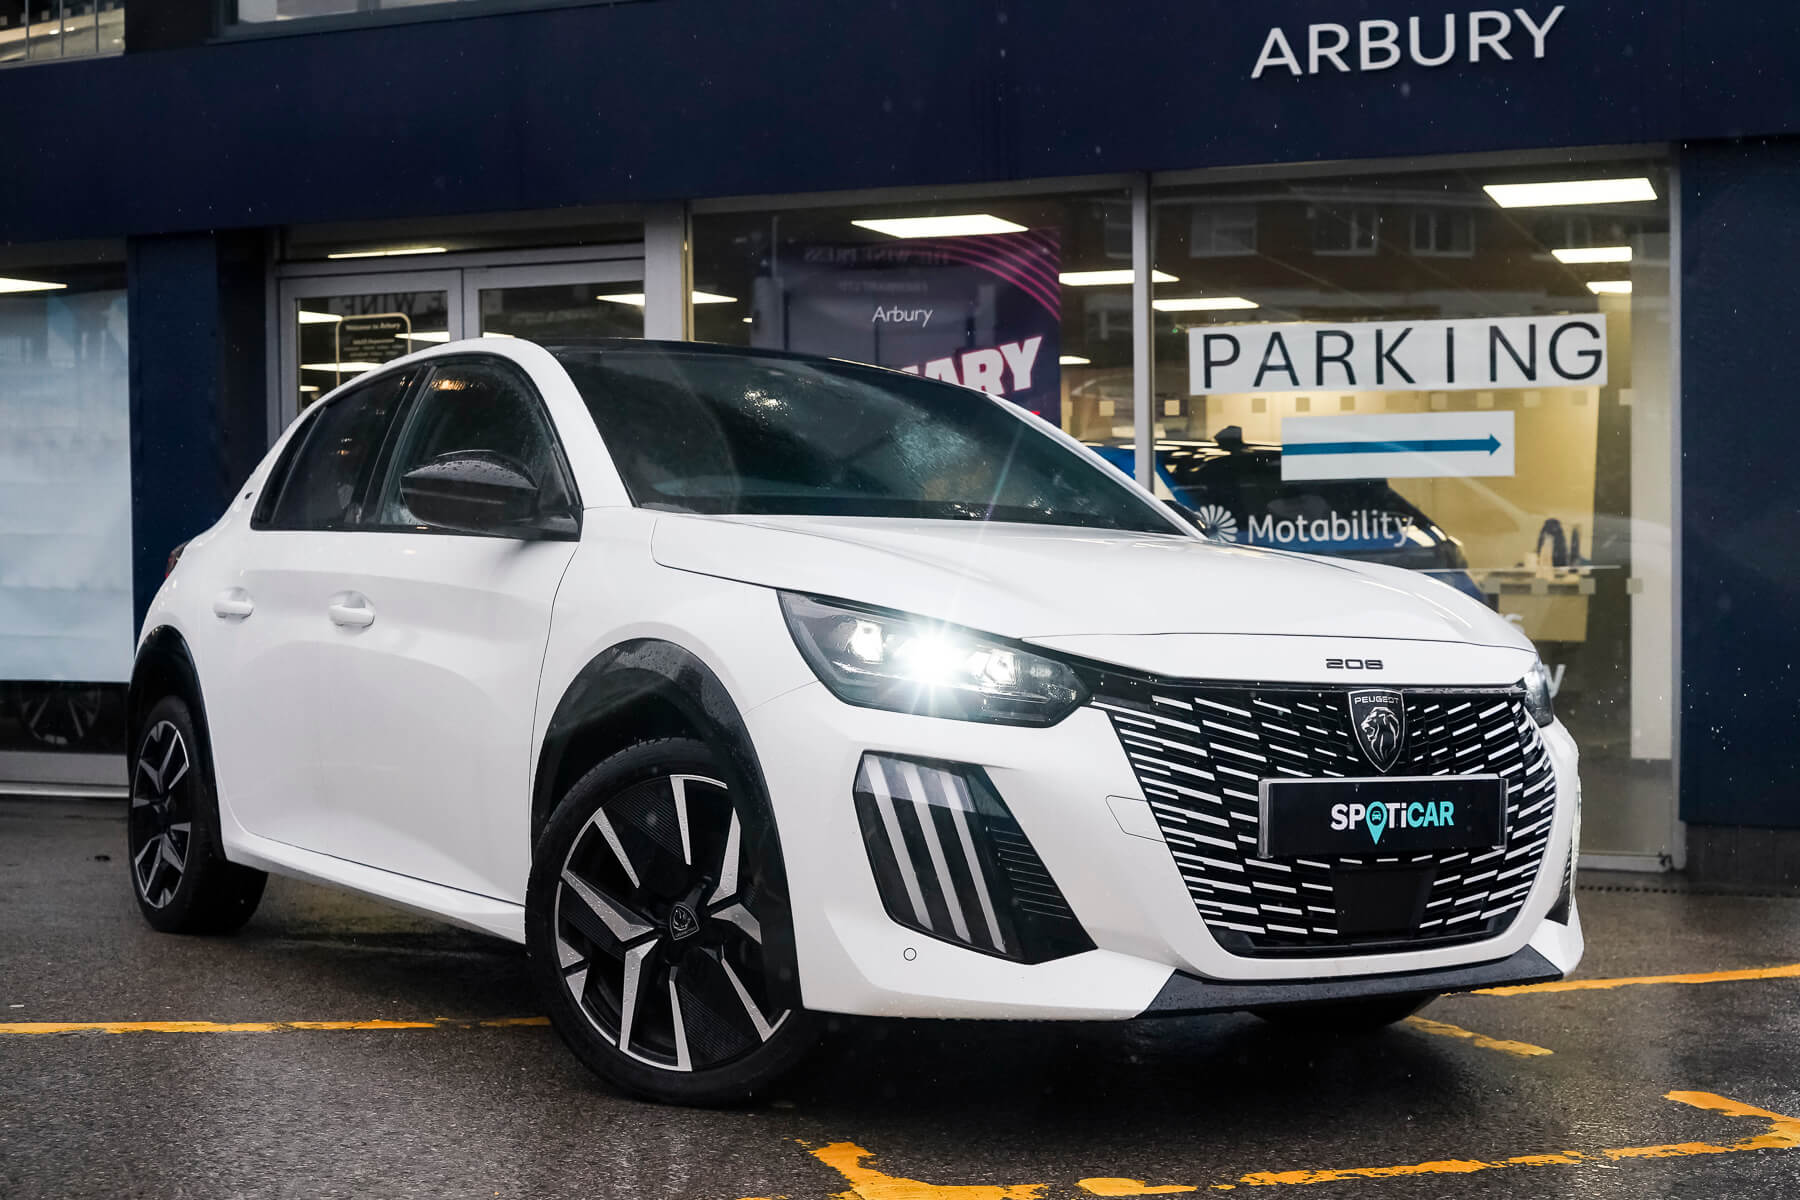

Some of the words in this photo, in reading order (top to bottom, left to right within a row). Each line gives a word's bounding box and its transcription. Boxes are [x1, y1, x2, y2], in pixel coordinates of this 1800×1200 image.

[1251, 5, 1565, 79] ARBURY
[872, 305, 933, 328] Arbury
[1203, 321, 1603, 389] PARKING
[1249, 509, 1413, 547] Motability
[1354, 695, 1399, 705] PEUGEOT
